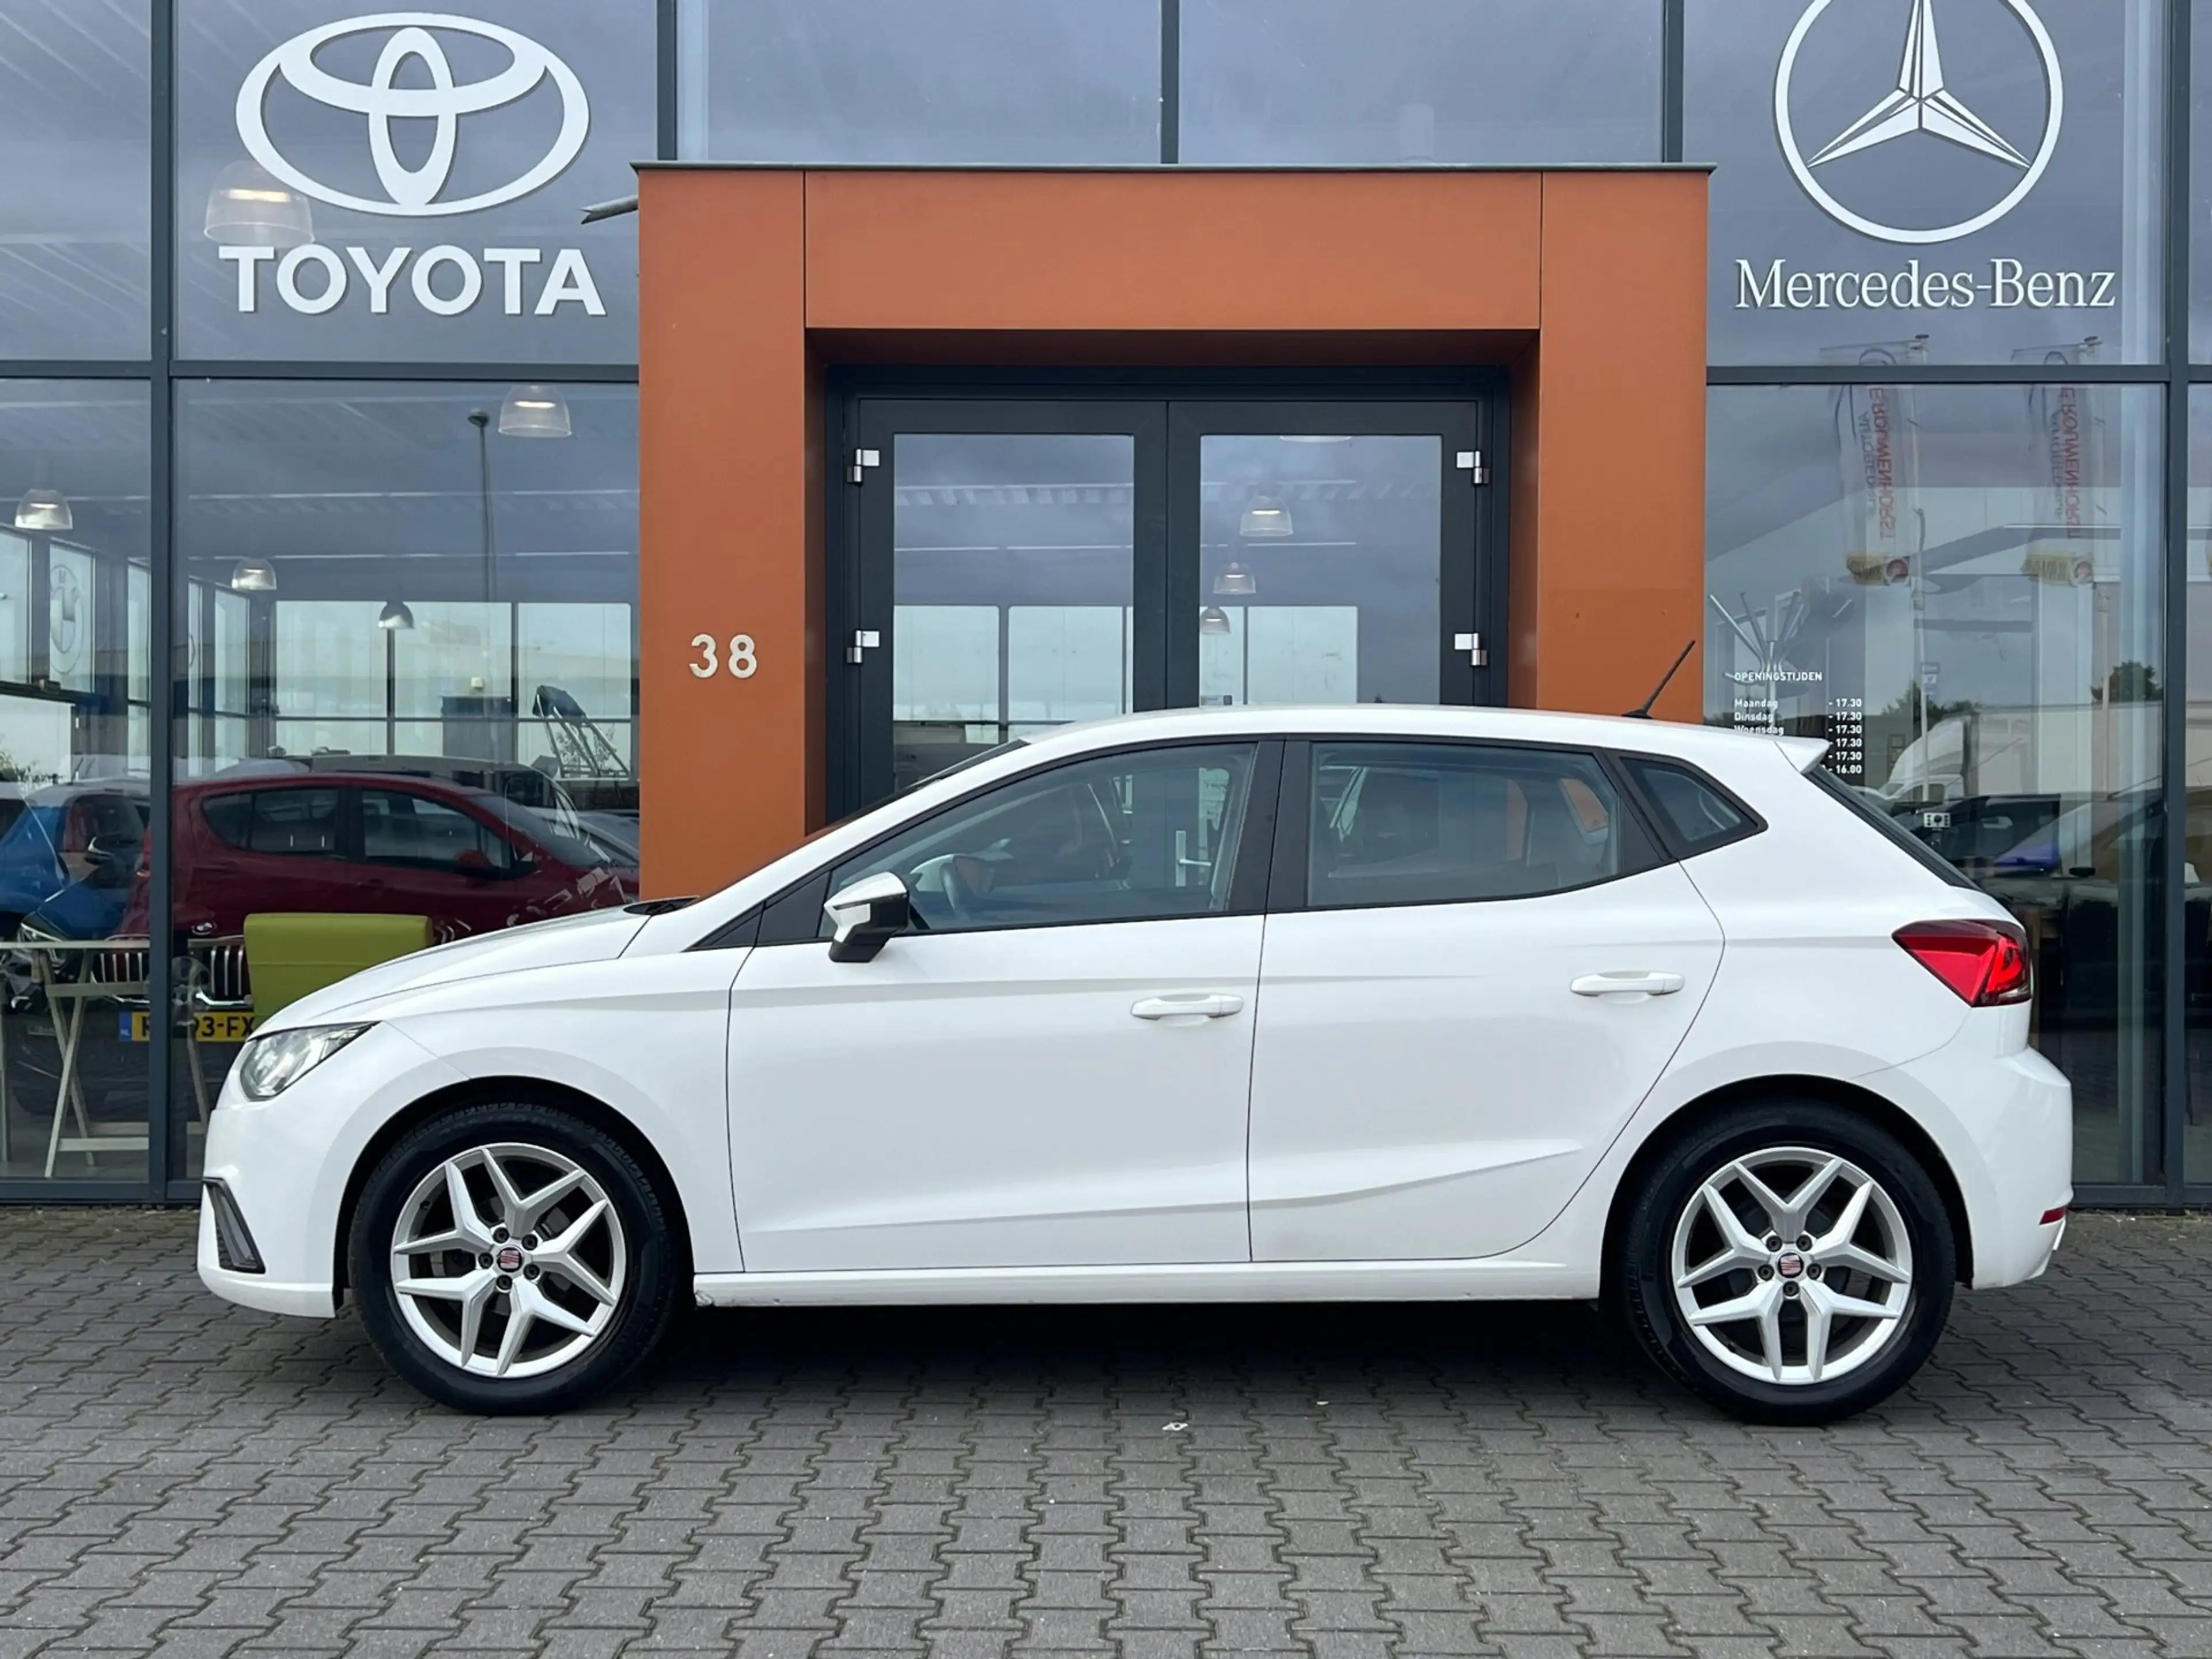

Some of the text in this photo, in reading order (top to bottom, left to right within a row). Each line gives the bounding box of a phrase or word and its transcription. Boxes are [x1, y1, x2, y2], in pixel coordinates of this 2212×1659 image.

[218, 244, 607, 315] TOYOTA
[1735, 258, 2116, 308] Mercedes-Benz
[690, 634, 757, 679] 38
[1734, 672, 1823, 681] OPENINGSTIJDEN
[1734, 699, 1778, 710] Maandag
[1836, 698, 1862, 707] 17.30
[1734, 712, 1774, 723] Dinsdag
[1836, 711, 1862, 721] 17.30
[1734, 725, 1785, 735] Woensdag
[1836, 725, 1862, 734] 17.30
[1836, 738, 1862, 748] 17.30
[1836, 752, 1862, 761] 17.30
[1836, 765, 1862, 774] 16.00
